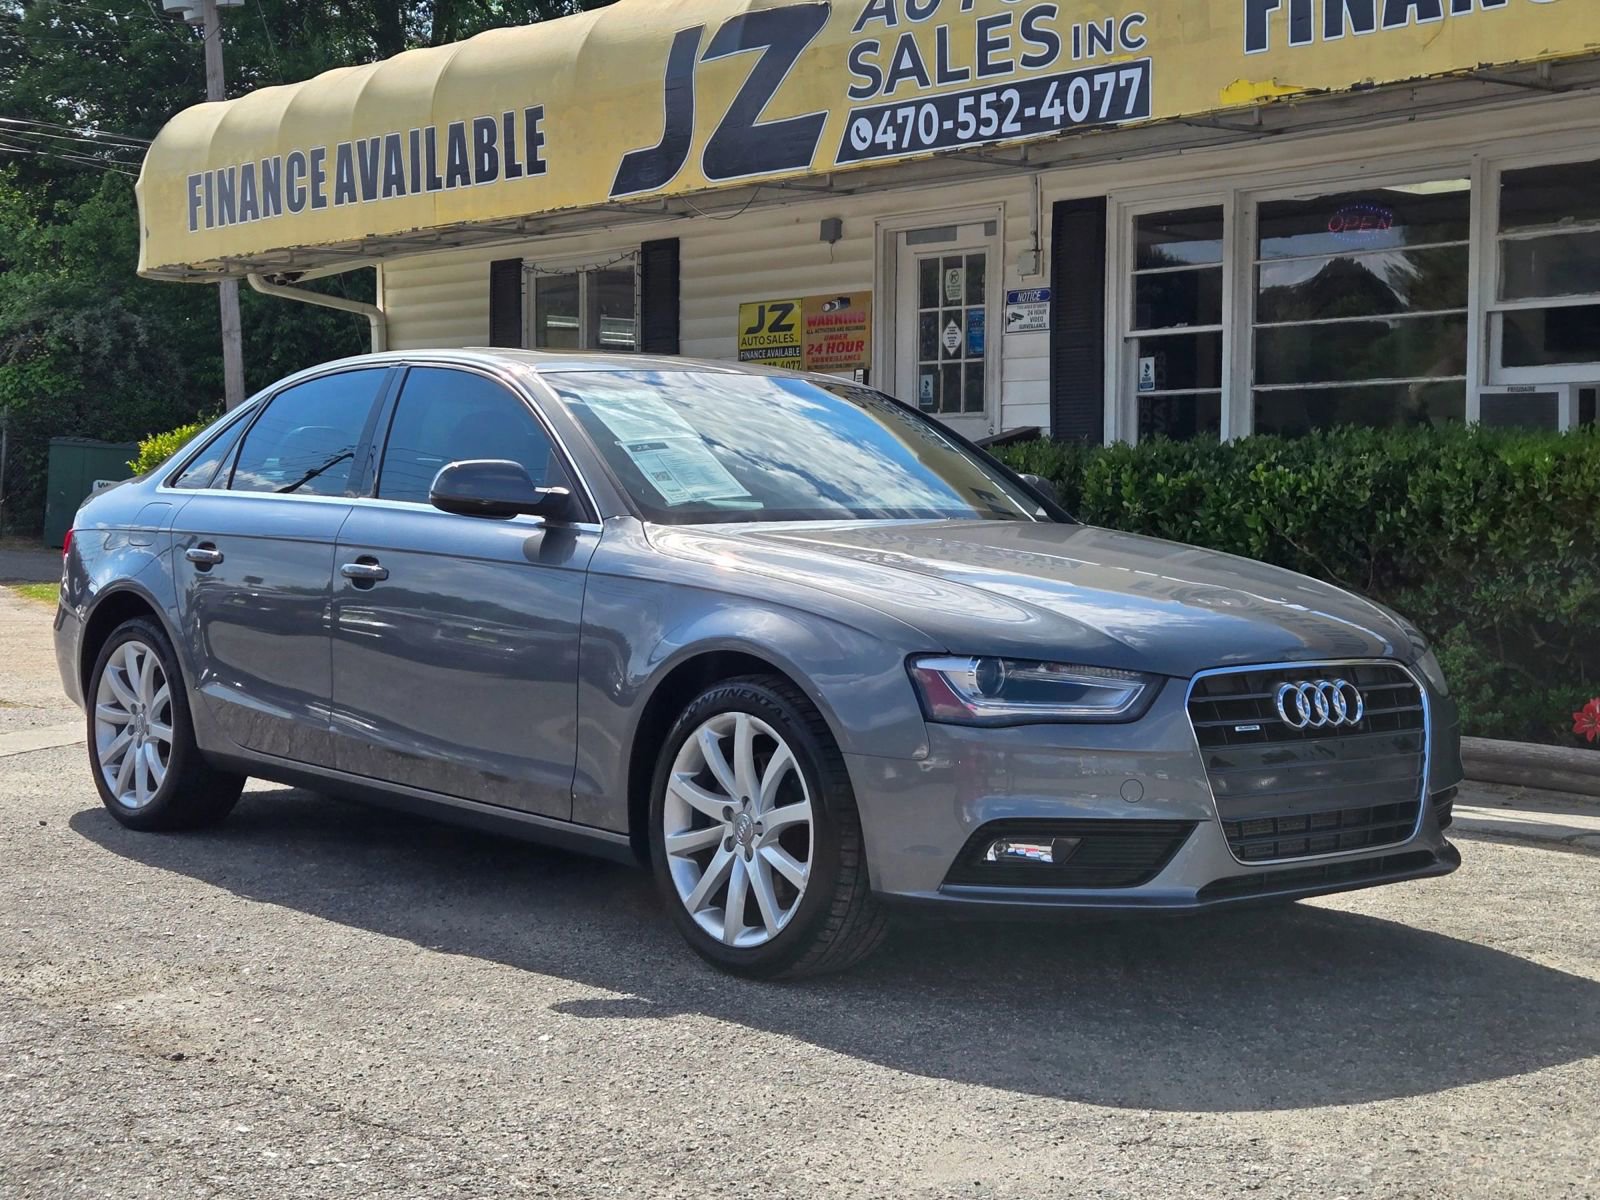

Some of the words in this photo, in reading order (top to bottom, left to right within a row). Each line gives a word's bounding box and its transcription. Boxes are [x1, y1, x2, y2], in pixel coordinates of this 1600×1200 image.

[847, 3, 1061, 100] SALES
[1071, 13, 1147, 60] INC
[608, 1, 831, 197] JZ
[875, 67, 1142, 150] 470-552-4077
[187, 146, 328, 232] FINANCE
[334, 104, 547, 207] AVAILABLE
[1328, 214, 1393, 234] OPEN
[1017, 290, 1041, 302] NOTICE
[745, 303, 795, 334] JZ
[807, 312, 865, 327] WARNING
[741, 335, 766, 346] AUTO
[767, 333, 794, 344] SALES
[824, 333, 848, 341] UNDER
[740, 349, 767, 361] FINANCE
[767, 347, 800, 358] AVAILABLE
[807, 343, 823, 355] 24
[827, 340, 865, 354] HOUR
[811, 354, 861, 364] SURVEILLANCE
